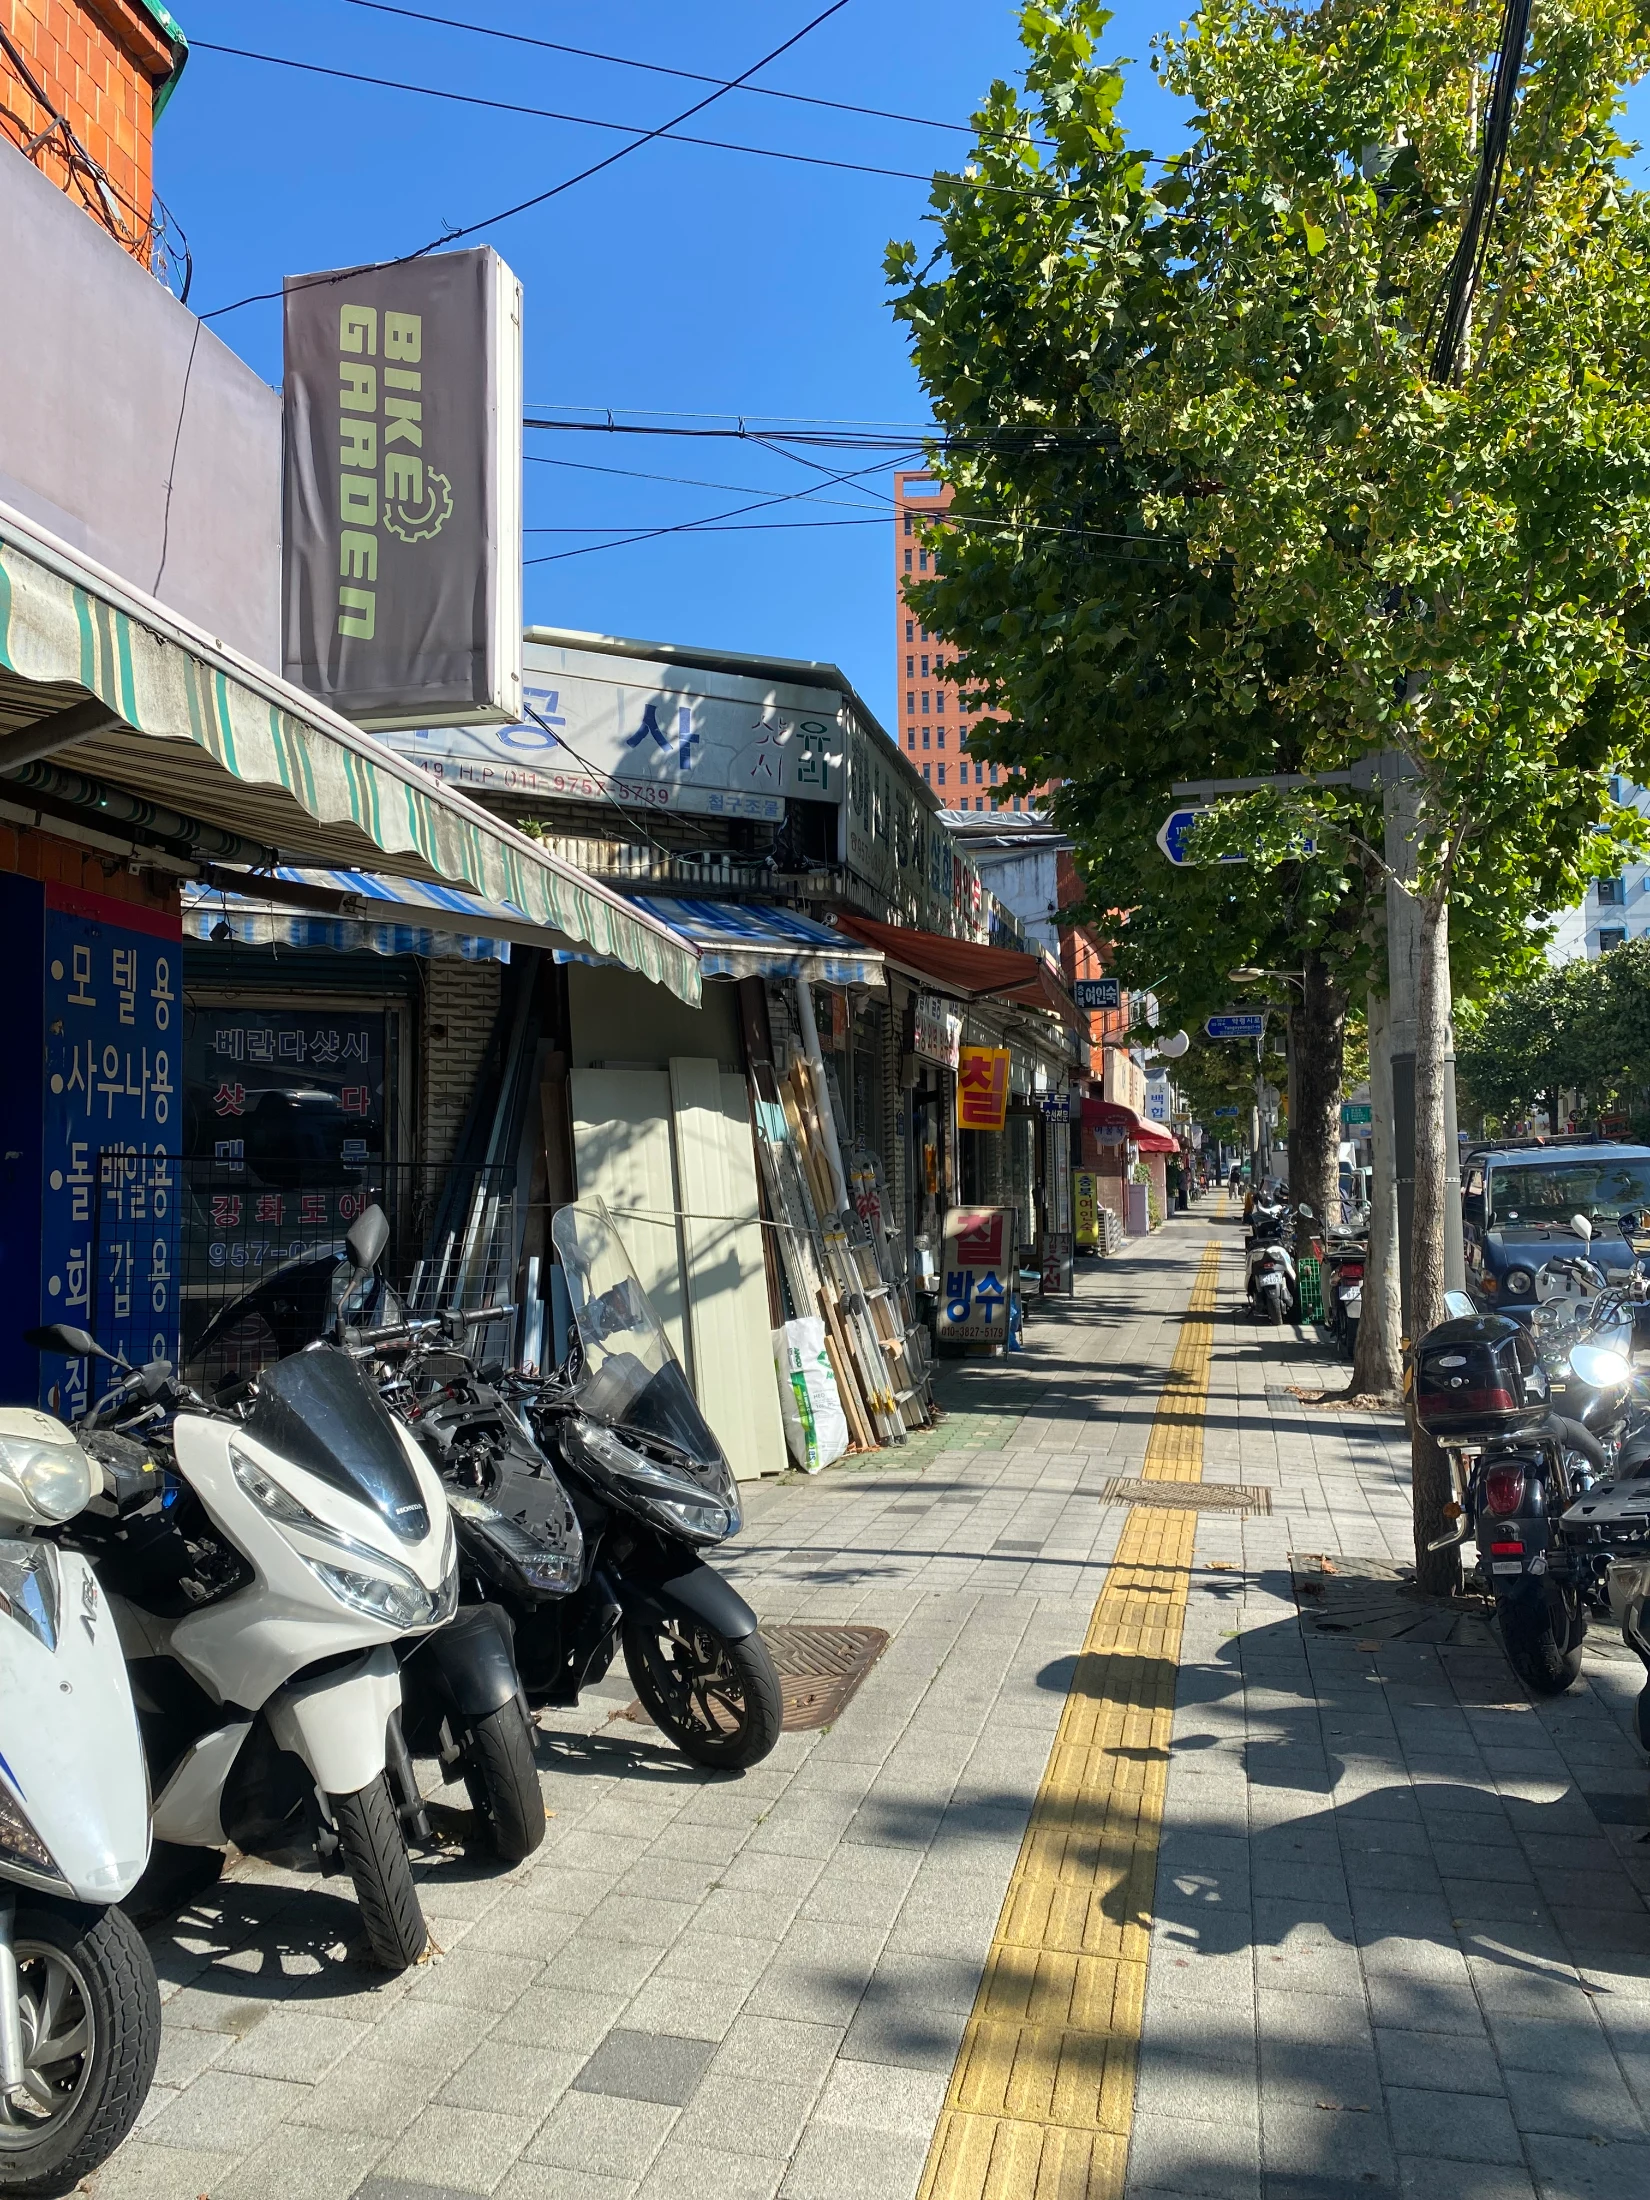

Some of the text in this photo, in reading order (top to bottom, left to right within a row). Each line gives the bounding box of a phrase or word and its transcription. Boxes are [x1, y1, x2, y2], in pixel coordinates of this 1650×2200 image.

[384, 310, 423, 505] BIKE
[338, 304, 378, 640] GARDEN
[796, 721, 831, 790] 유리
[709, 793, 779, 818] 철구조물
[214, 1028, 369, 1063] 베란다샷시
[67, 1039, 174, 1124] 사우나용
[960, 1055, 1006, 1125] 칠
[1035, 1094, 1069, 1109] 구두
[1150, 1093, 1165, 1119] 백합
[953, 1214, 1003, 1266] 칠
[946, 1270, 1005, 1324] 방수
[941, 1326, 1003, 1338] 010-3827-5179
[395, 1503, 424, 1515] HONDA
